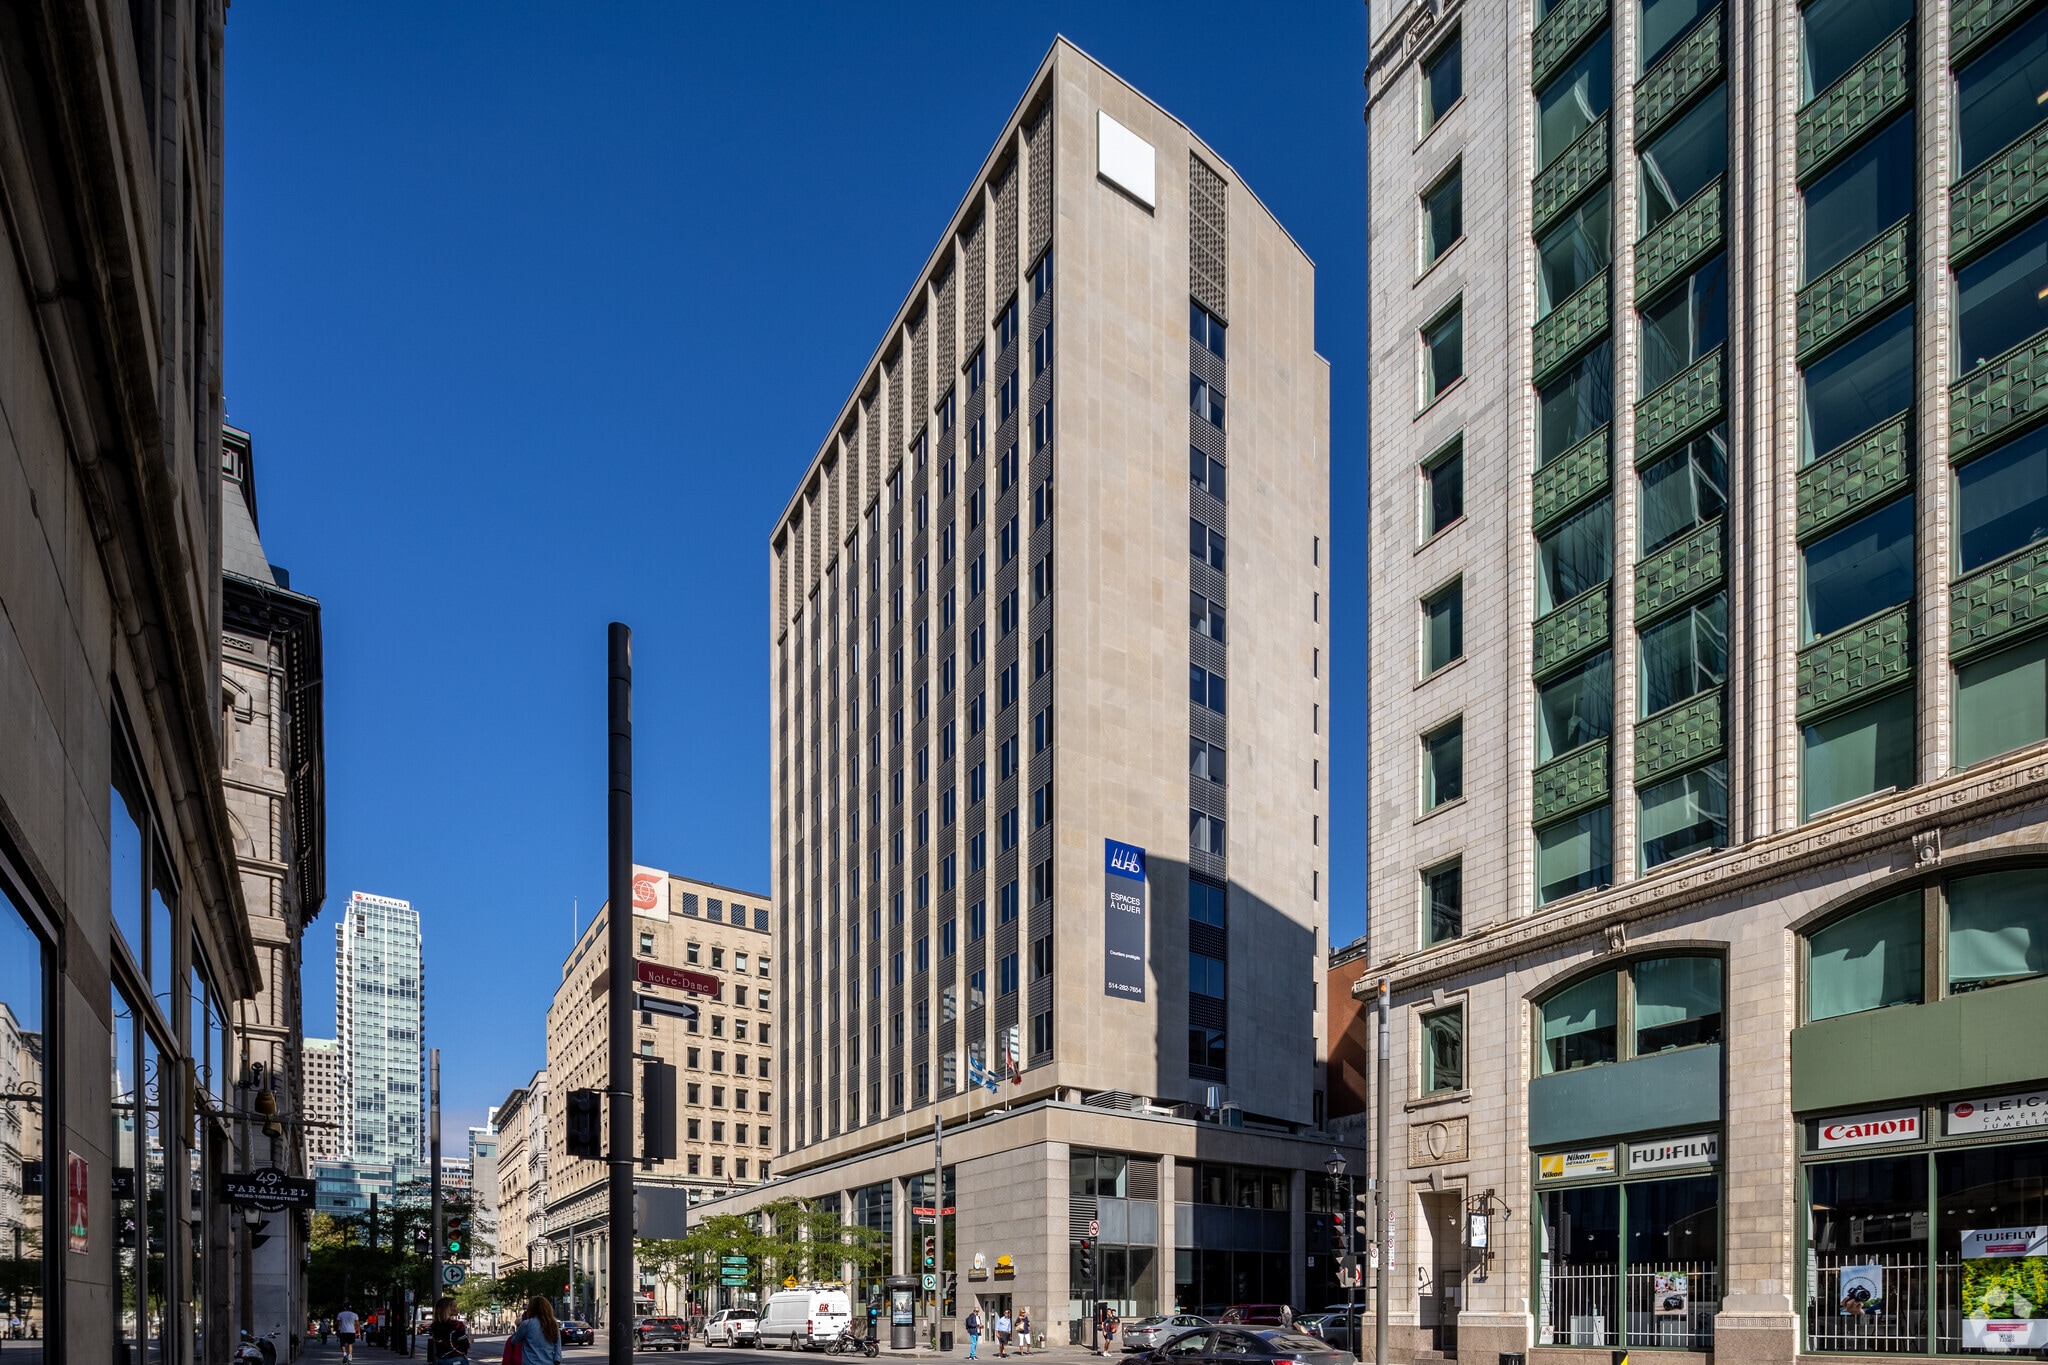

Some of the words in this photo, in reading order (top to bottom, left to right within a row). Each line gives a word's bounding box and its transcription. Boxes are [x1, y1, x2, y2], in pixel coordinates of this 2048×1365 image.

[379, 898, 408, 908] CANADA
[1110, 892, 1141, 906] ESPACES
[1116, 902, 1141, 915] LOUER
[648, 971, 709, 992] Notre-Dame
[1983, 1096, 2048, 1113] LEIC
[1823, 1116, 1915, 1141] Canon
[1566, 1153, 1591, 1162] Nikon
[1632, 1141, 1716, 1163] FUJIFILM
[1542, 1171, 1563, 1179] Nikon
[227, 1184, 308, 1197] PARALLEL
[1976, 1230, 2036, 1242] FUJIFILM
[818, 1303, 830, 1312] GR
